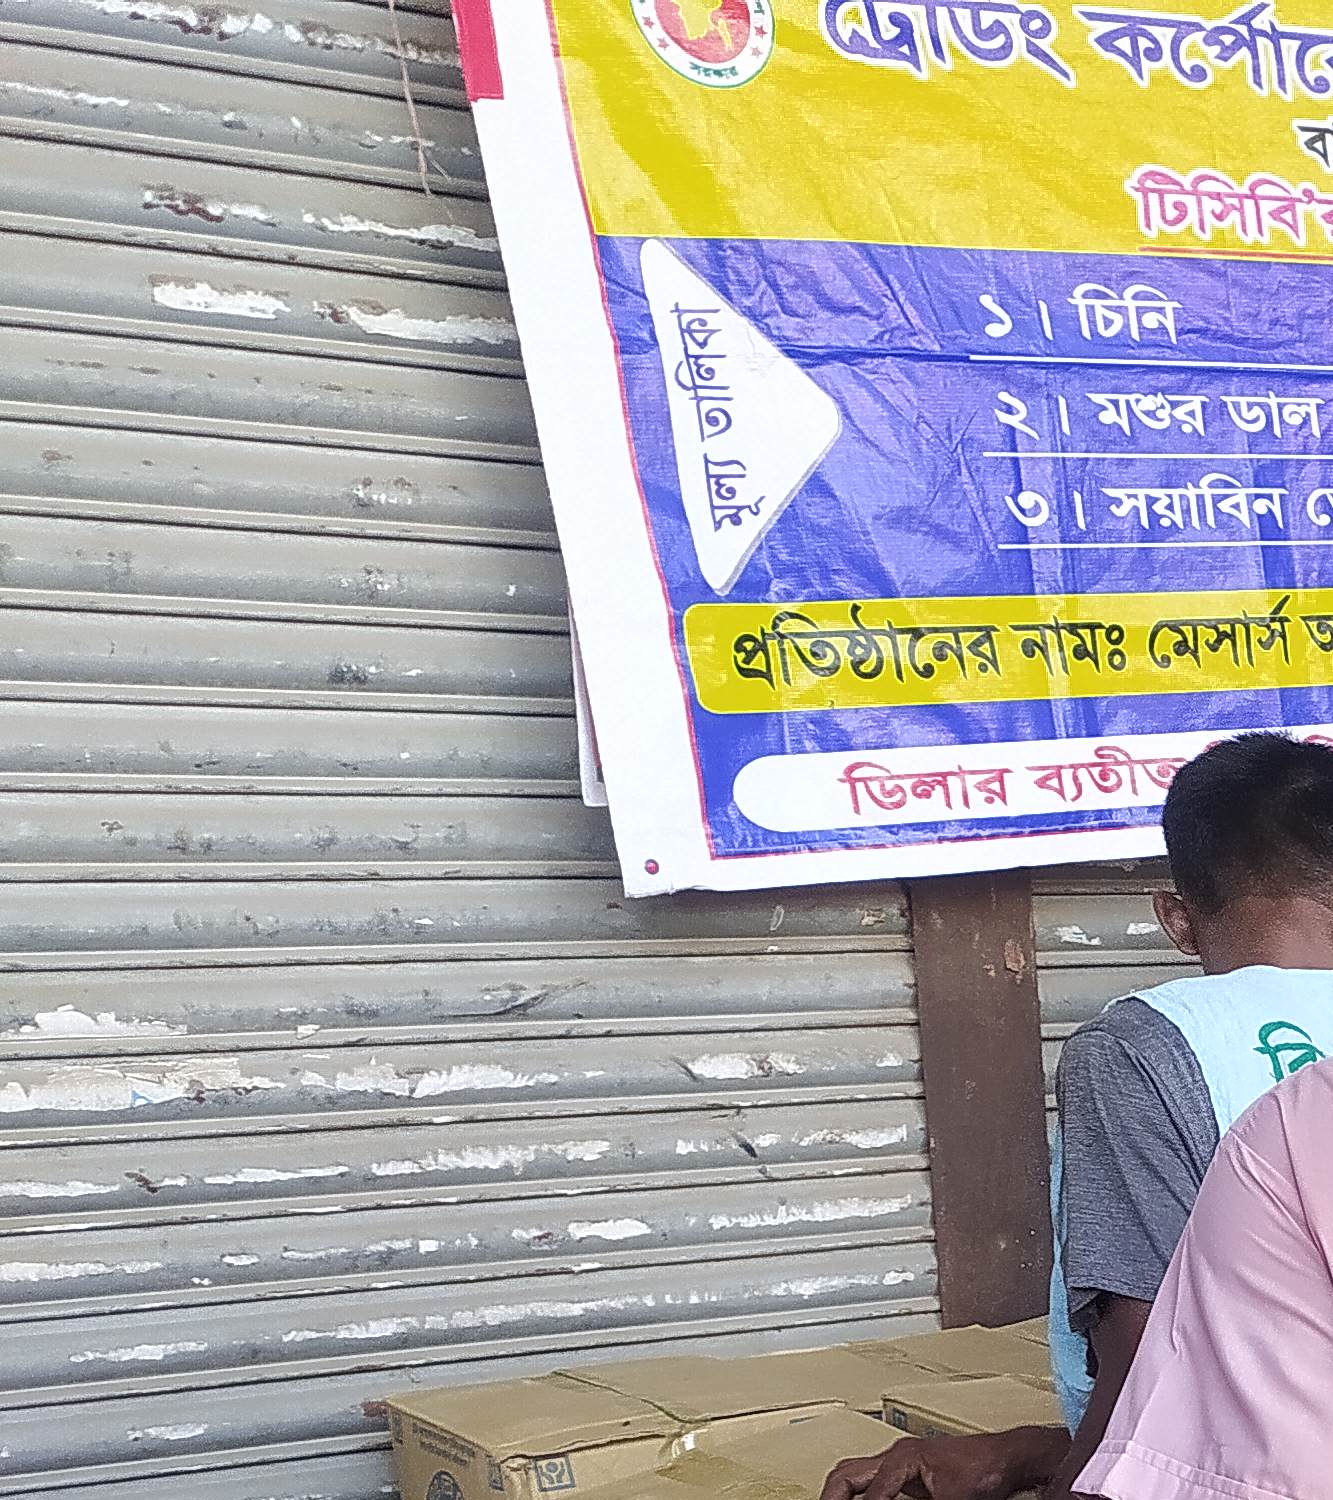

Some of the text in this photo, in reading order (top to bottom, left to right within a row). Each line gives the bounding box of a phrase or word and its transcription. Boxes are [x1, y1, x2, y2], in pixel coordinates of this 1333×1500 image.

[1068, 283, 1184, 344] চিনি
[669, 302, 766, 533] মূল্য তালিকা
[1086, 391, 1210, 438] মশুর
[1220, 391, 1325, 440] ডাল
[1101, 472, 1290, 530] সয়াবিন
[731, 601, 1003, 692] প্রতিষ্ঠানের
[1145, 593, 1291, 671] মেসার্স
[836, 760, 1007, 819] ডিলার
